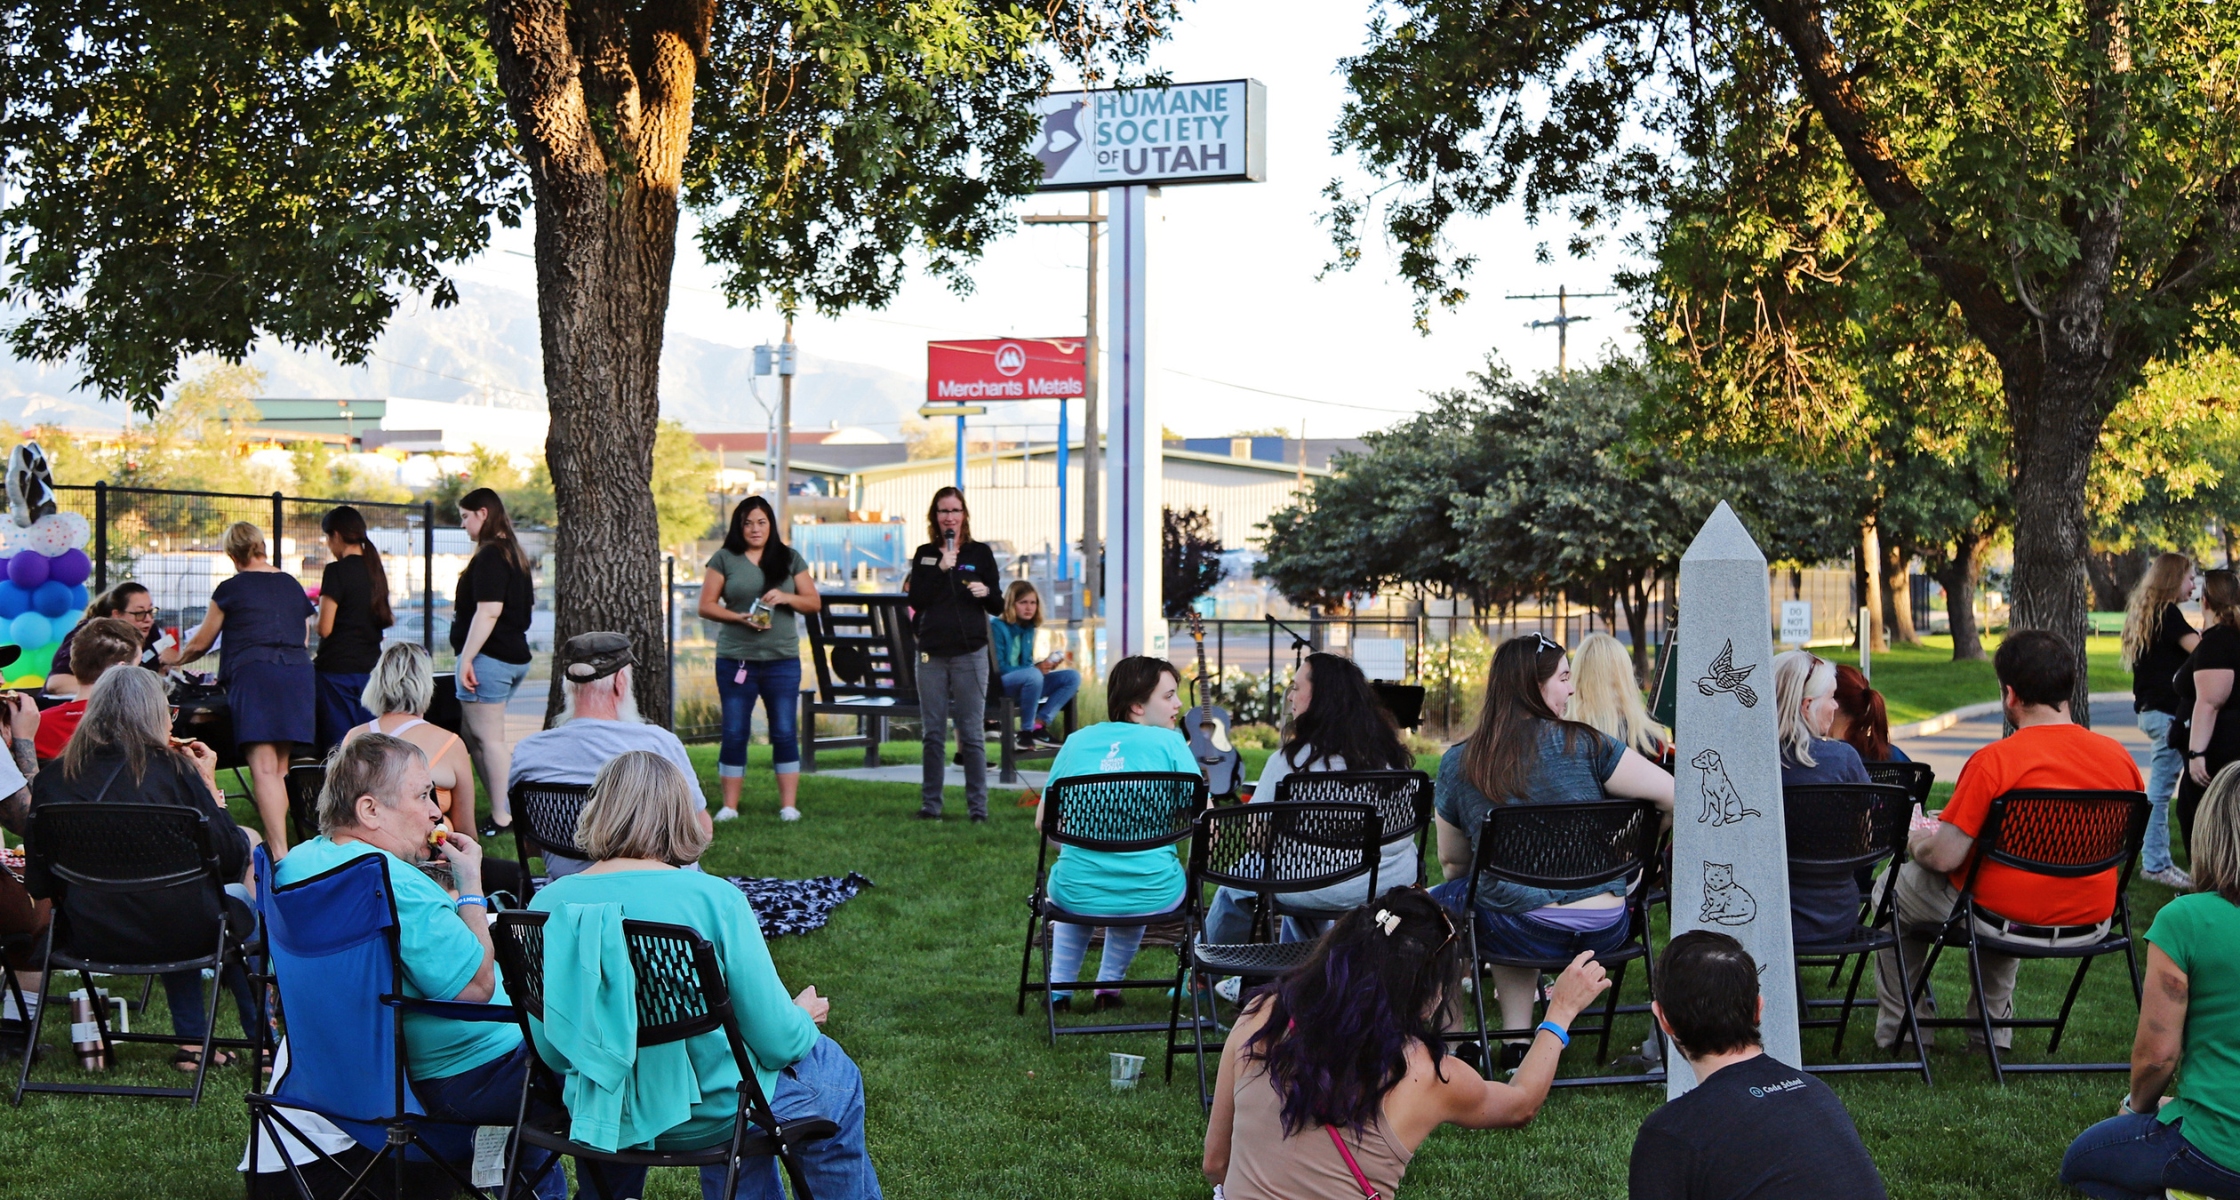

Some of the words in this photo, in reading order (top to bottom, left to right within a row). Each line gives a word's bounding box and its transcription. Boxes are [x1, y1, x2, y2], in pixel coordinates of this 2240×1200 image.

[1097, 87, 1228, 119] HUMANE
[1097, 114, 1230, 147] SOCIETY
[1097, 150, 1119, 166] OF
[1123, 143, 1227, 176] UTAH
[938, 379, 1024, 398] Merchants
[1027, 376, 1083, 396] Metals
[1789, 608, 1802, 616] DO
[1787, 618, 1803, 626] NOT
[1783, 629, 1809, 637] ENTER
[1762, 1083, 1782, 1093] Code
[1779, 1077, 1804, 1089] School
